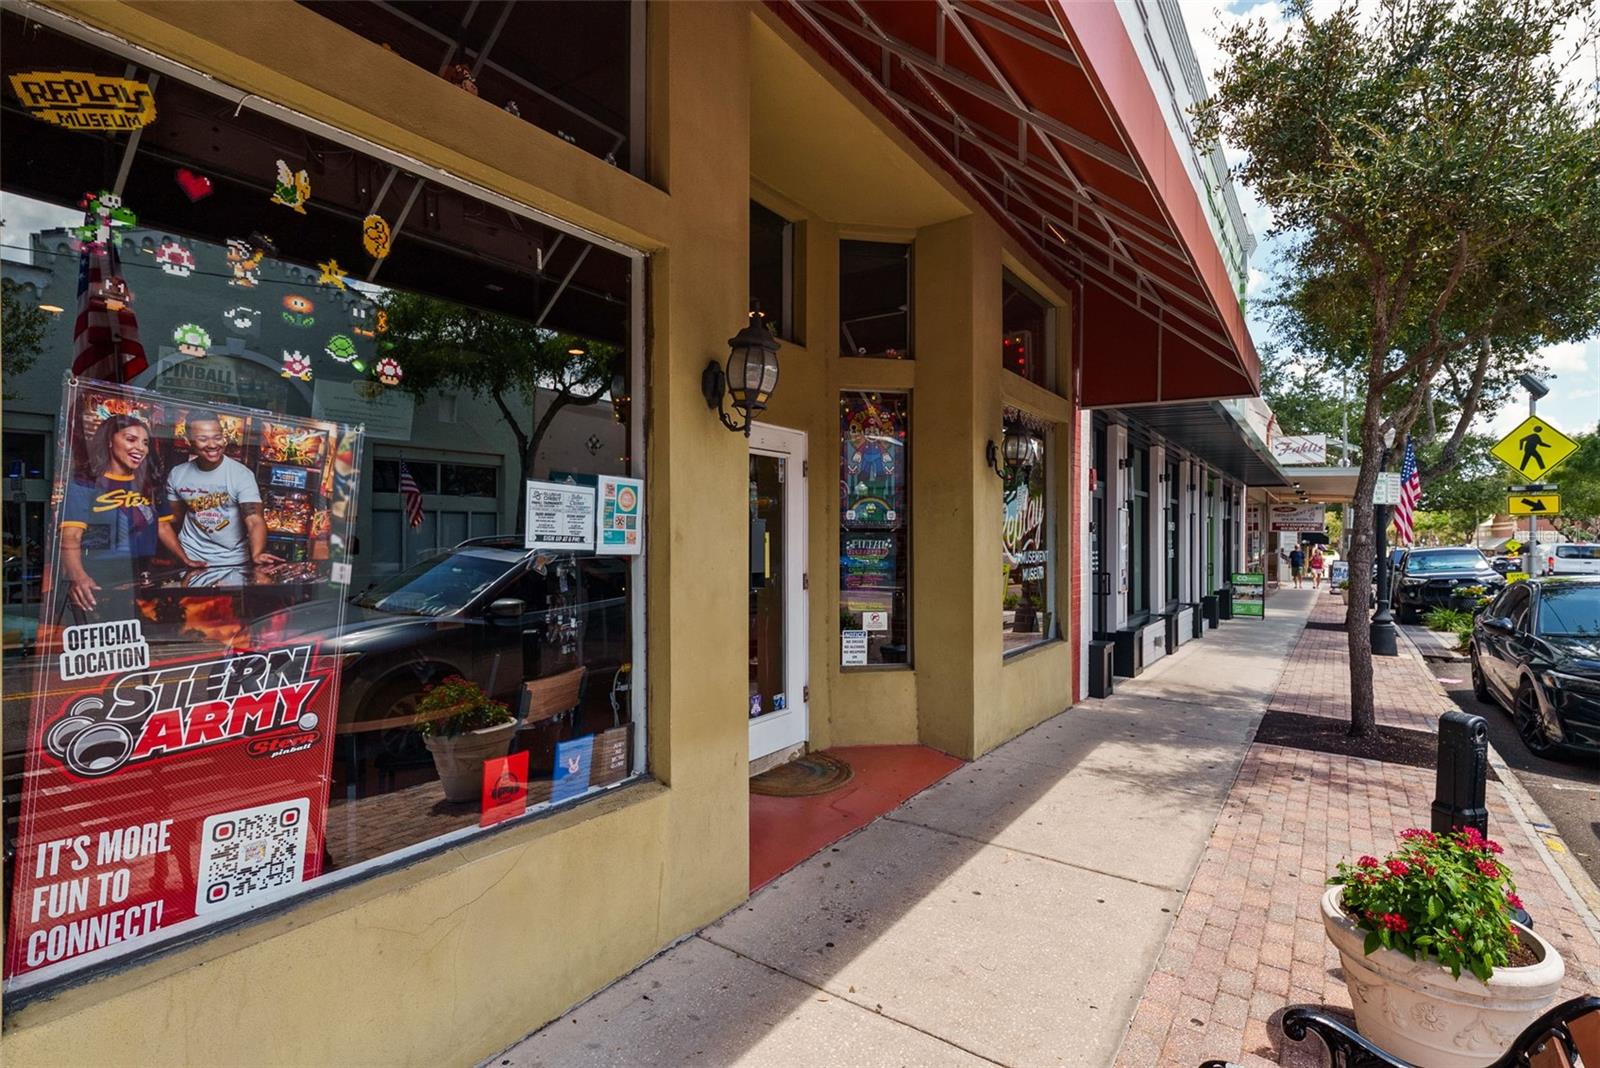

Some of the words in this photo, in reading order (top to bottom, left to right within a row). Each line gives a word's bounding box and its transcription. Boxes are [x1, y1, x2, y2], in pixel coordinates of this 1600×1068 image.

[21, 79, 149, 108] REPLAY
[57, 112, 141, 128] MUSEUM
[161, 360, 234, 386] PINBALL
[1014, 550, 1049, 563] AMUSEMENT
[1022, 566, 1044, 580] MUSEUM
[67, 622, 141, 651] OFFICIAL
[64, 646, 145, 677] LOCATION
[106, 645, 312, 721] STERN
[129, 679, 322, 760] ARMY
[254, 733, 315, 753] Stern
[271, 742, 312, 759] pinball
[96, 819, 174, 866] MORE
[30, 877, 89, 924] FUN
[97, 868, 131, 907] TO
[26, 899, 164, 968] CONNECT!
